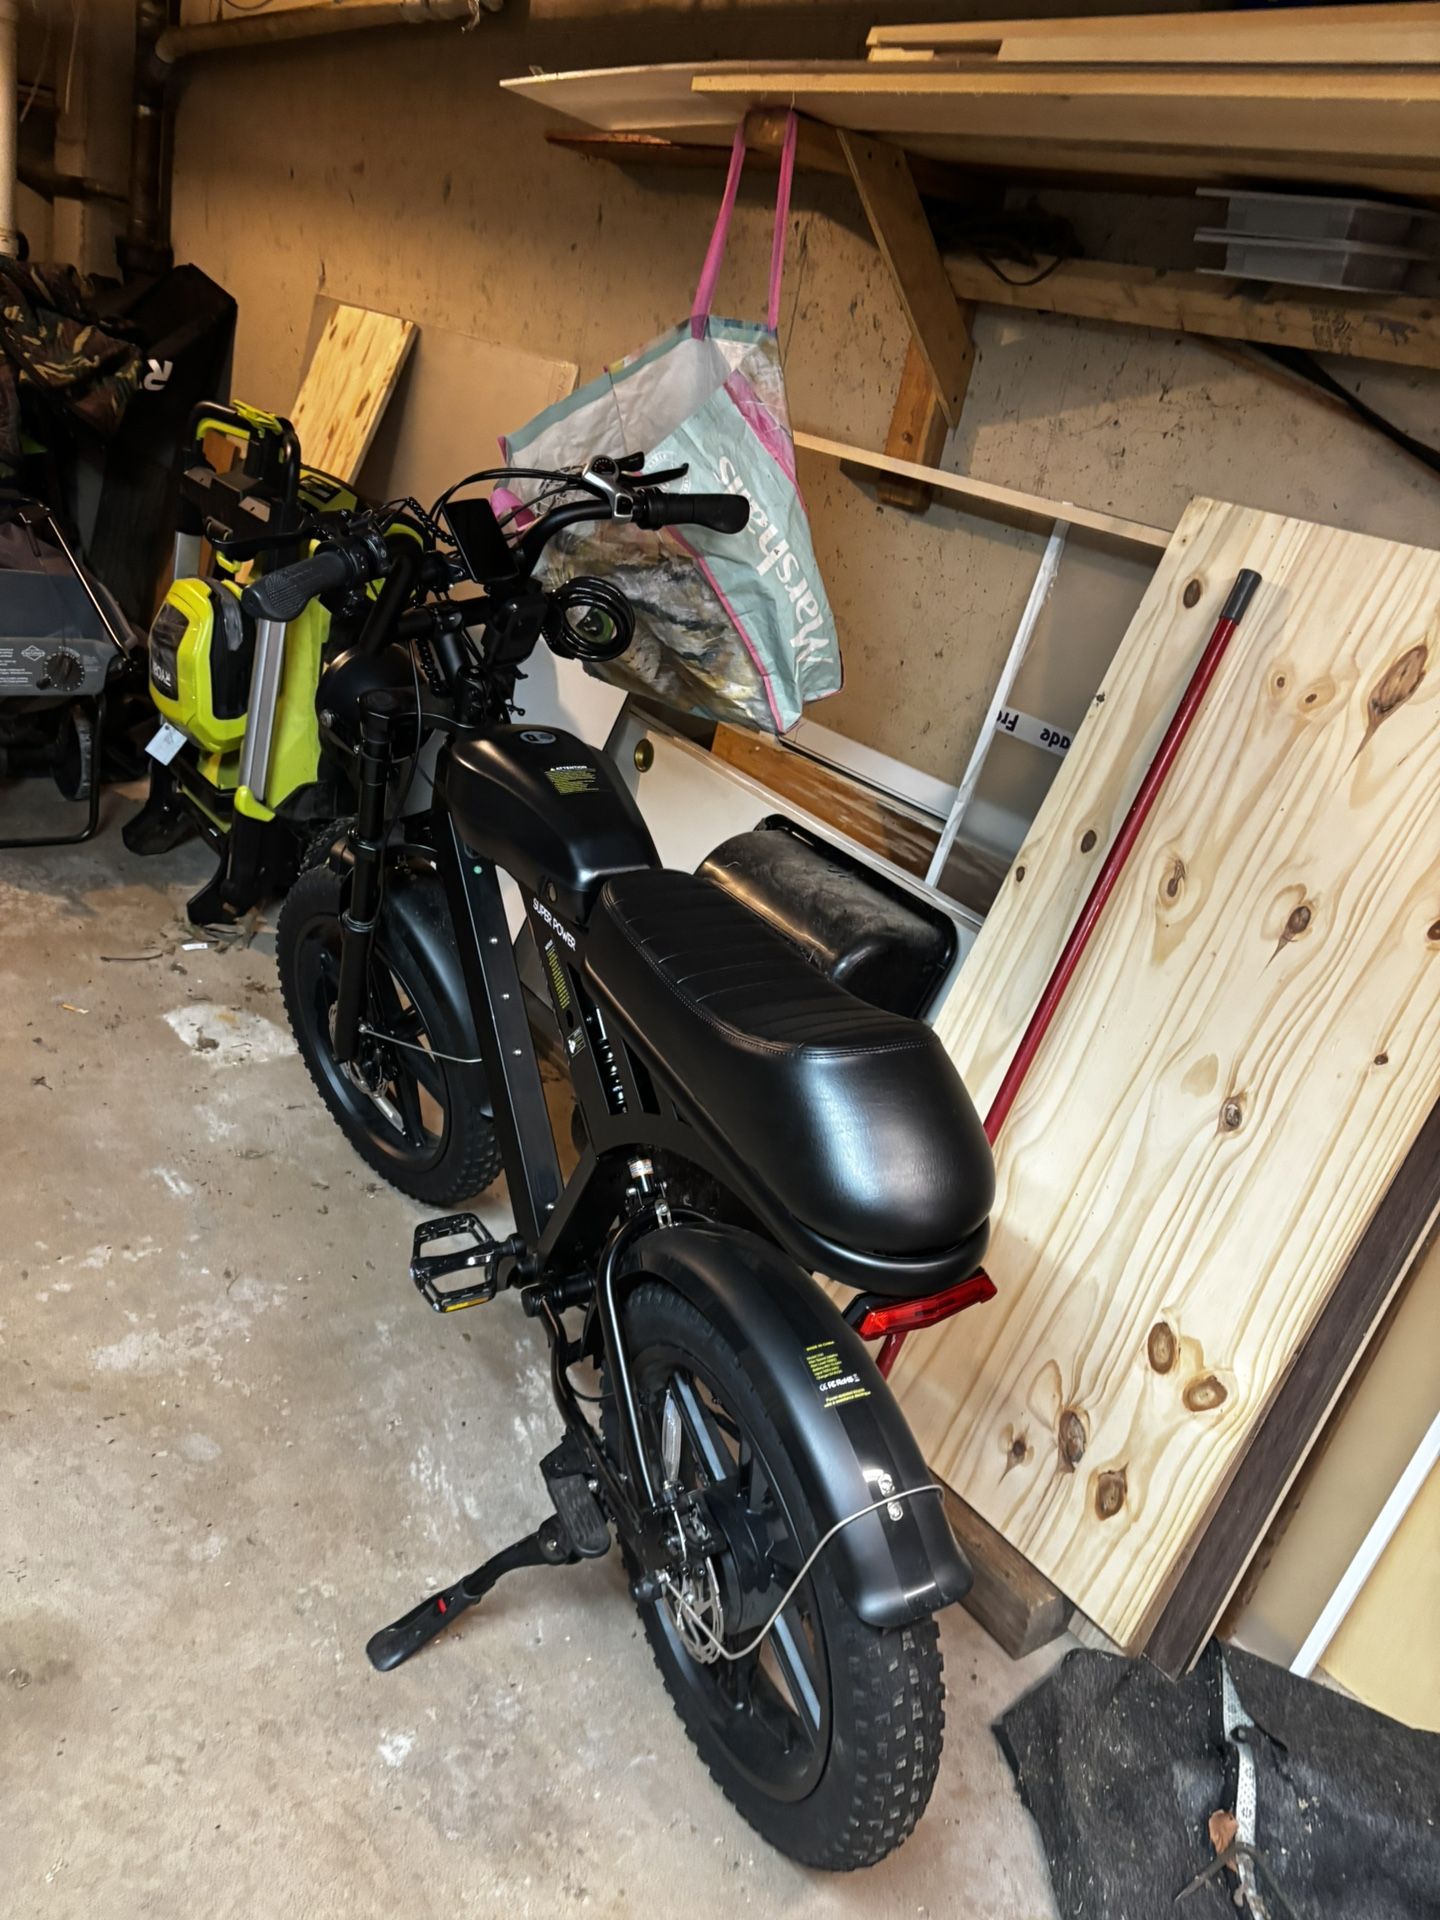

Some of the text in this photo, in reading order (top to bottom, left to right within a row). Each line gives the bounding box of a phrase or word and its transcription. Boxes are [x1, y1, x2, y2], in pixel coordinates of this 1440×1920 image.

[713, 456, 833, 664] Marshas
[533, 897, 553, 927] SUPER
[552, 917, 576, 951] POWER
